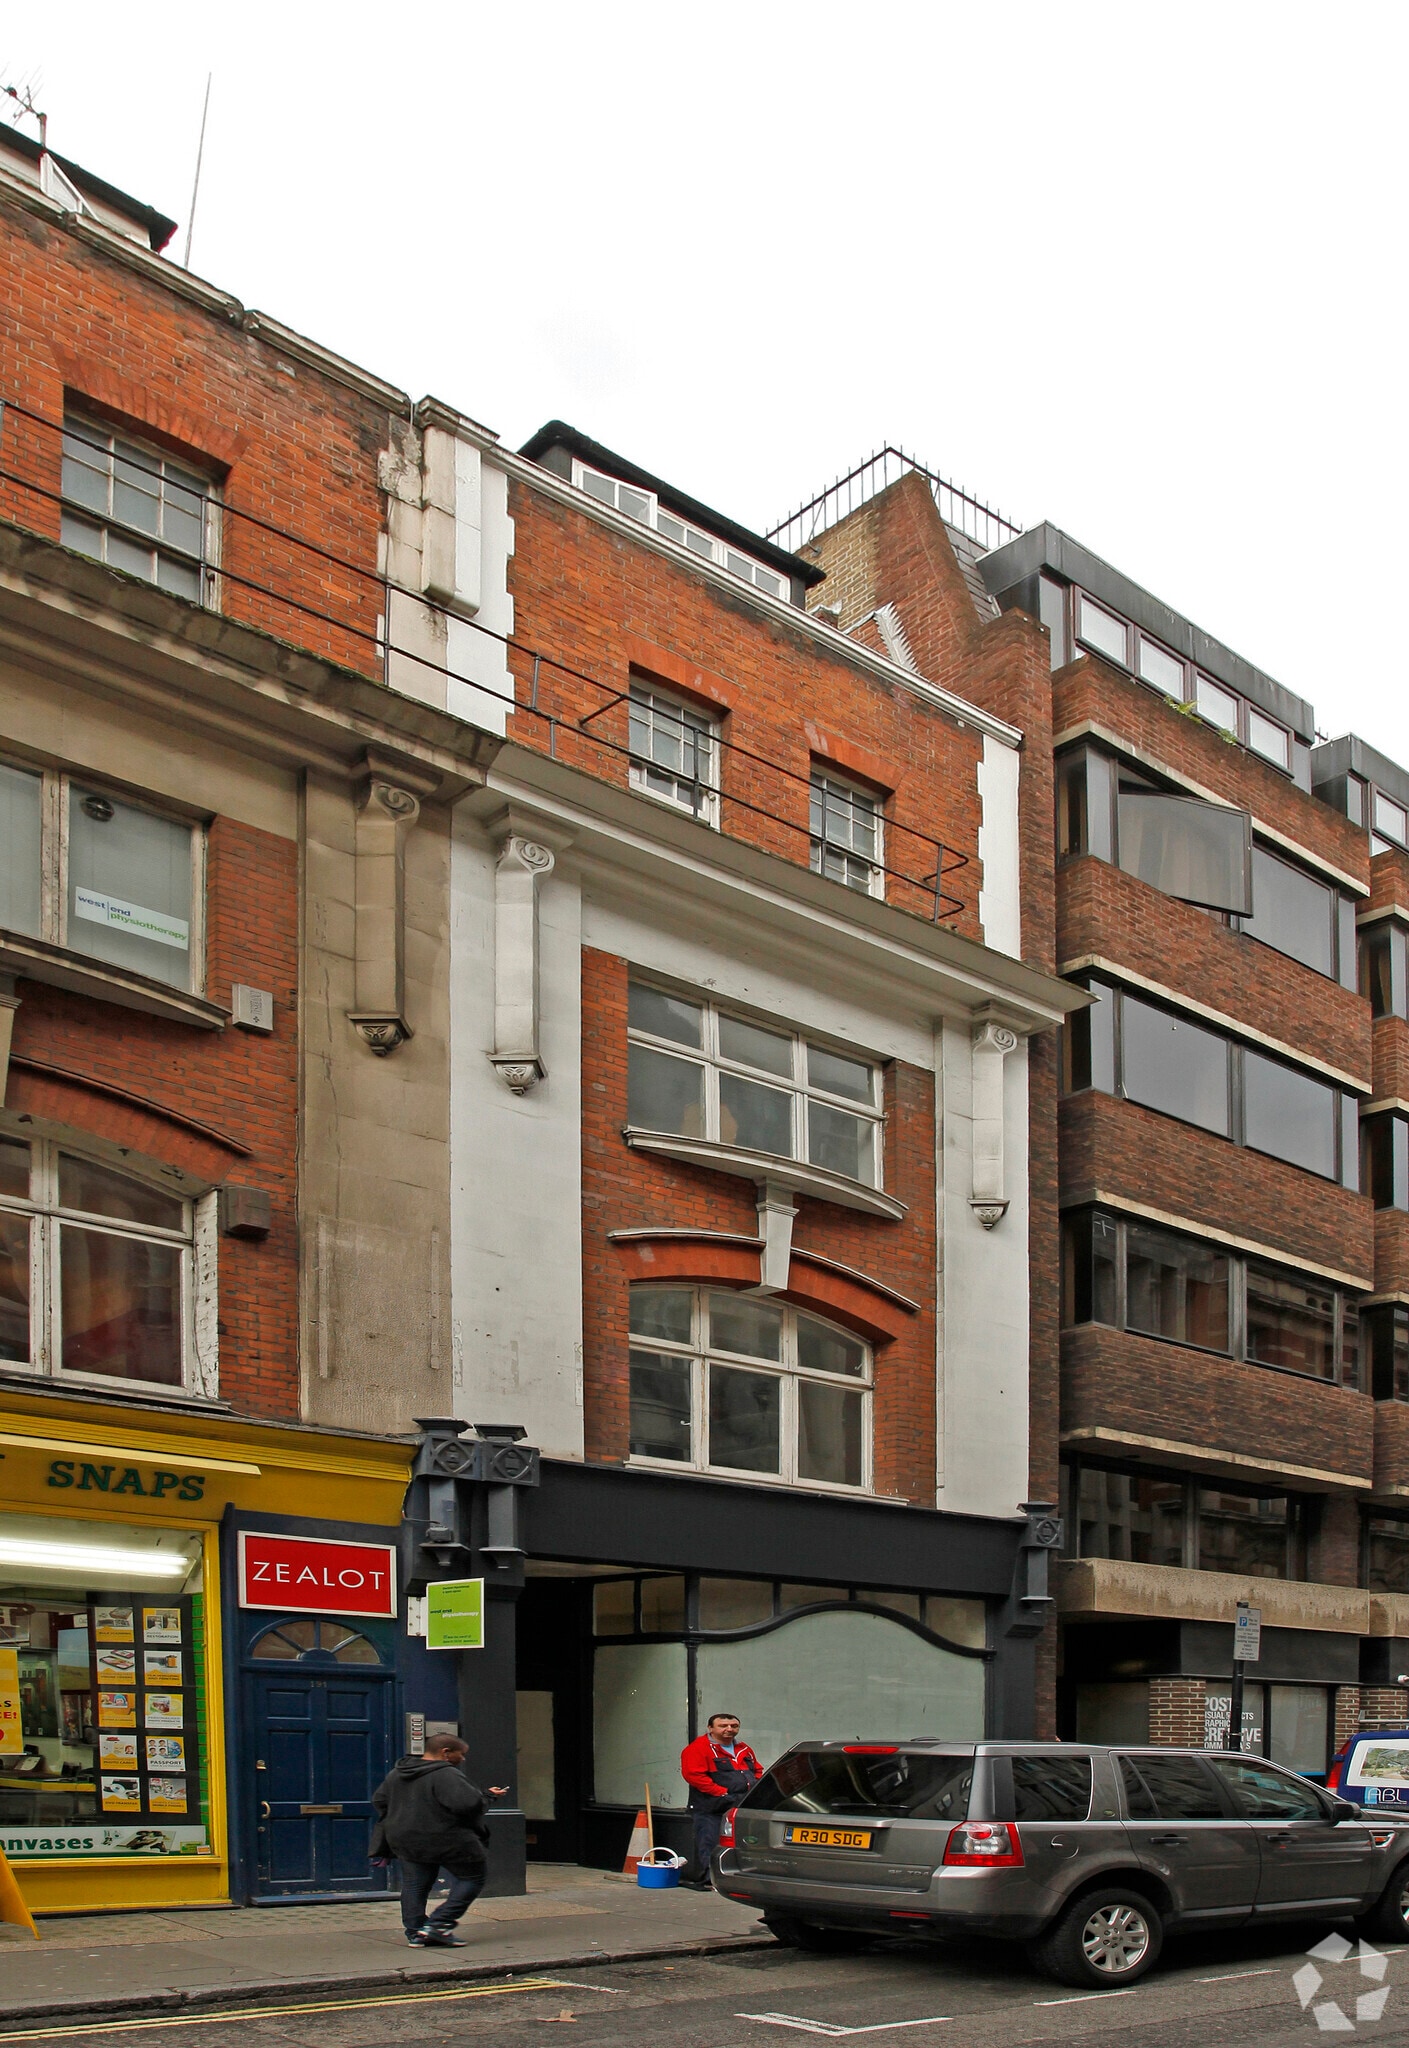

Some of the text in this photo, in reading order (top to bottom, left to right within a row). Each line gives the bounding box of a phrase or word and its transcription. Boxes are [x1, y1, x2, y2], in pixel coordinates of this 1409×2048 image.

[77, 895, 131, 917] west end
[110, 913, 187, 941] physiotherapy
[48, 1460, 206, 1501] SNAPS
[252, 1561, 385, 1590] ZEALOT
[0, 1711, 17, 1719] E!
[1367, 1787, 1407, 1803] ABL
[800, 1830, 863, 1846] R30 SDG
